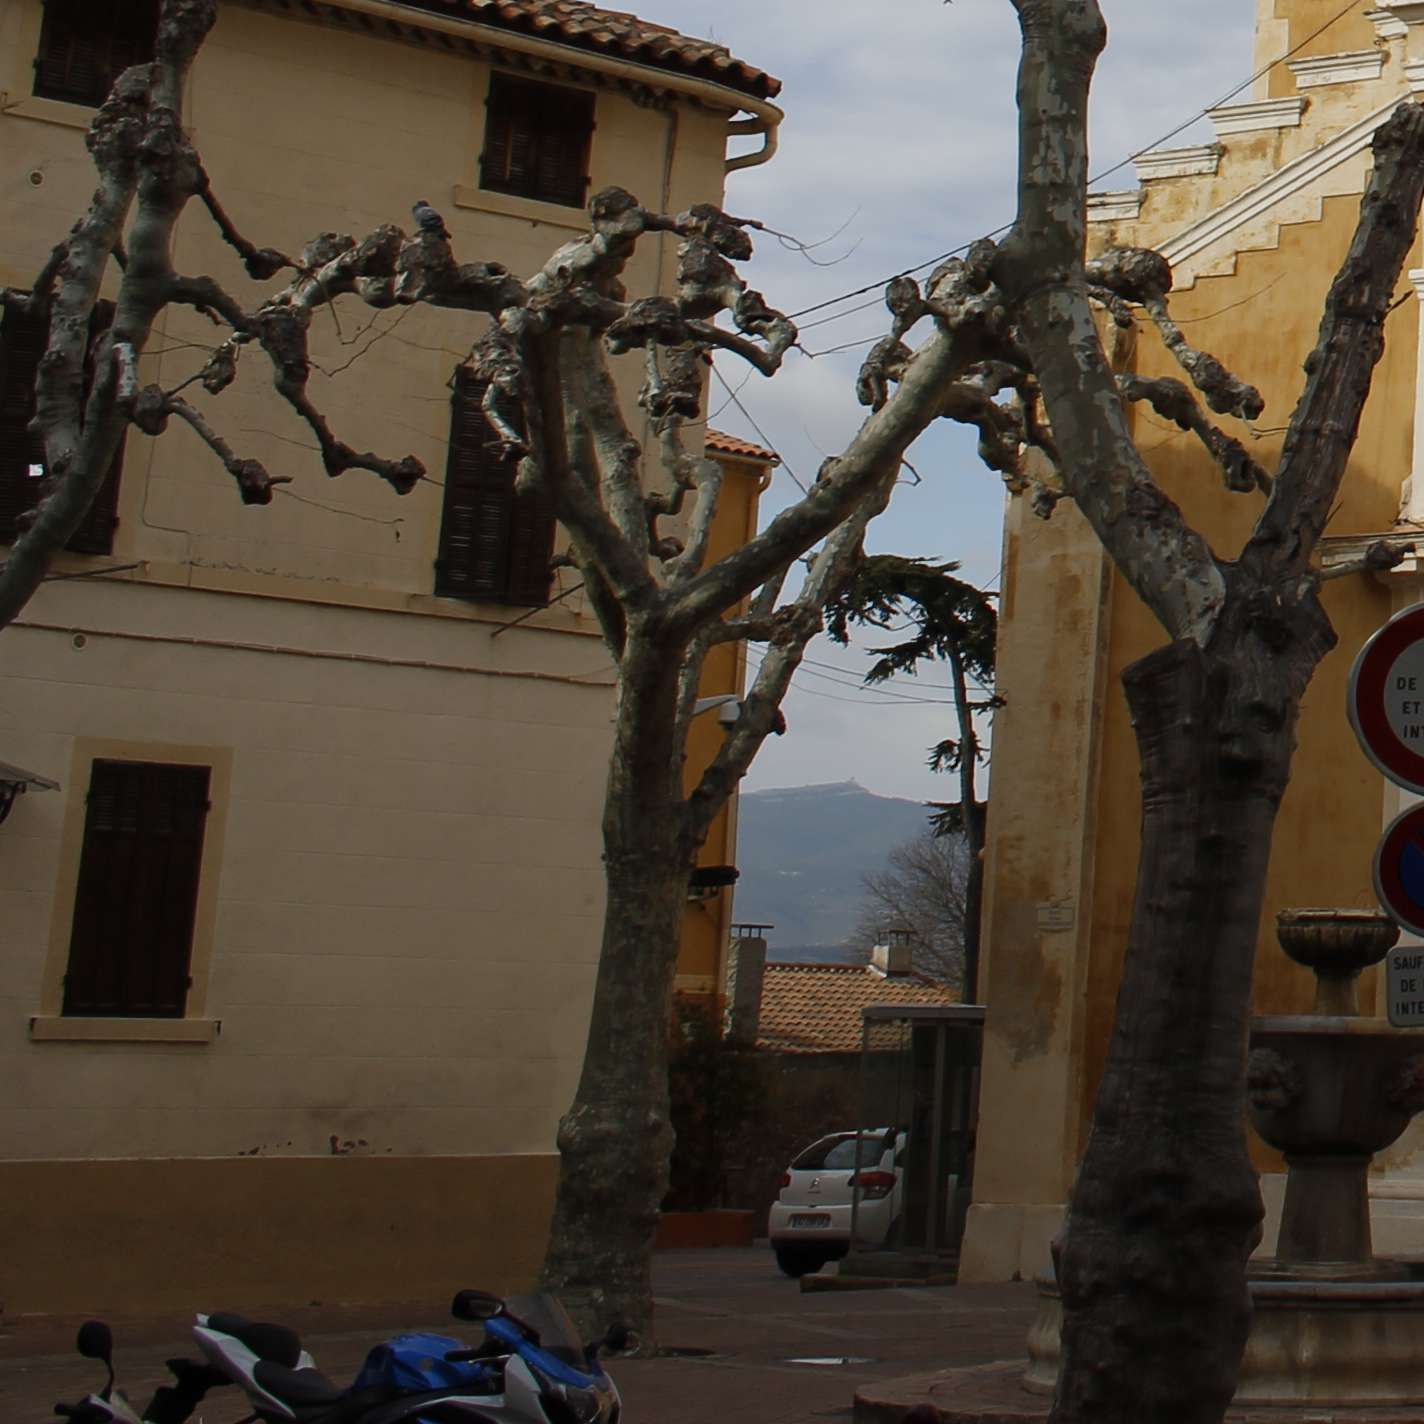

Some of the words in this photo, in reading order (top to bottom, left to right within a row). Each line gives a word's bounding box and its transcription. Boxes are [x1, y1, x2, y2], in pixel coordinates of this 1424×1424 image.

[1396, 677, 1417, 691] DE
[1402, 701, 1420, 714] ET
[1393, 956, 1424, 970] SAUF
[1400, 978, 1417, 992] DE
